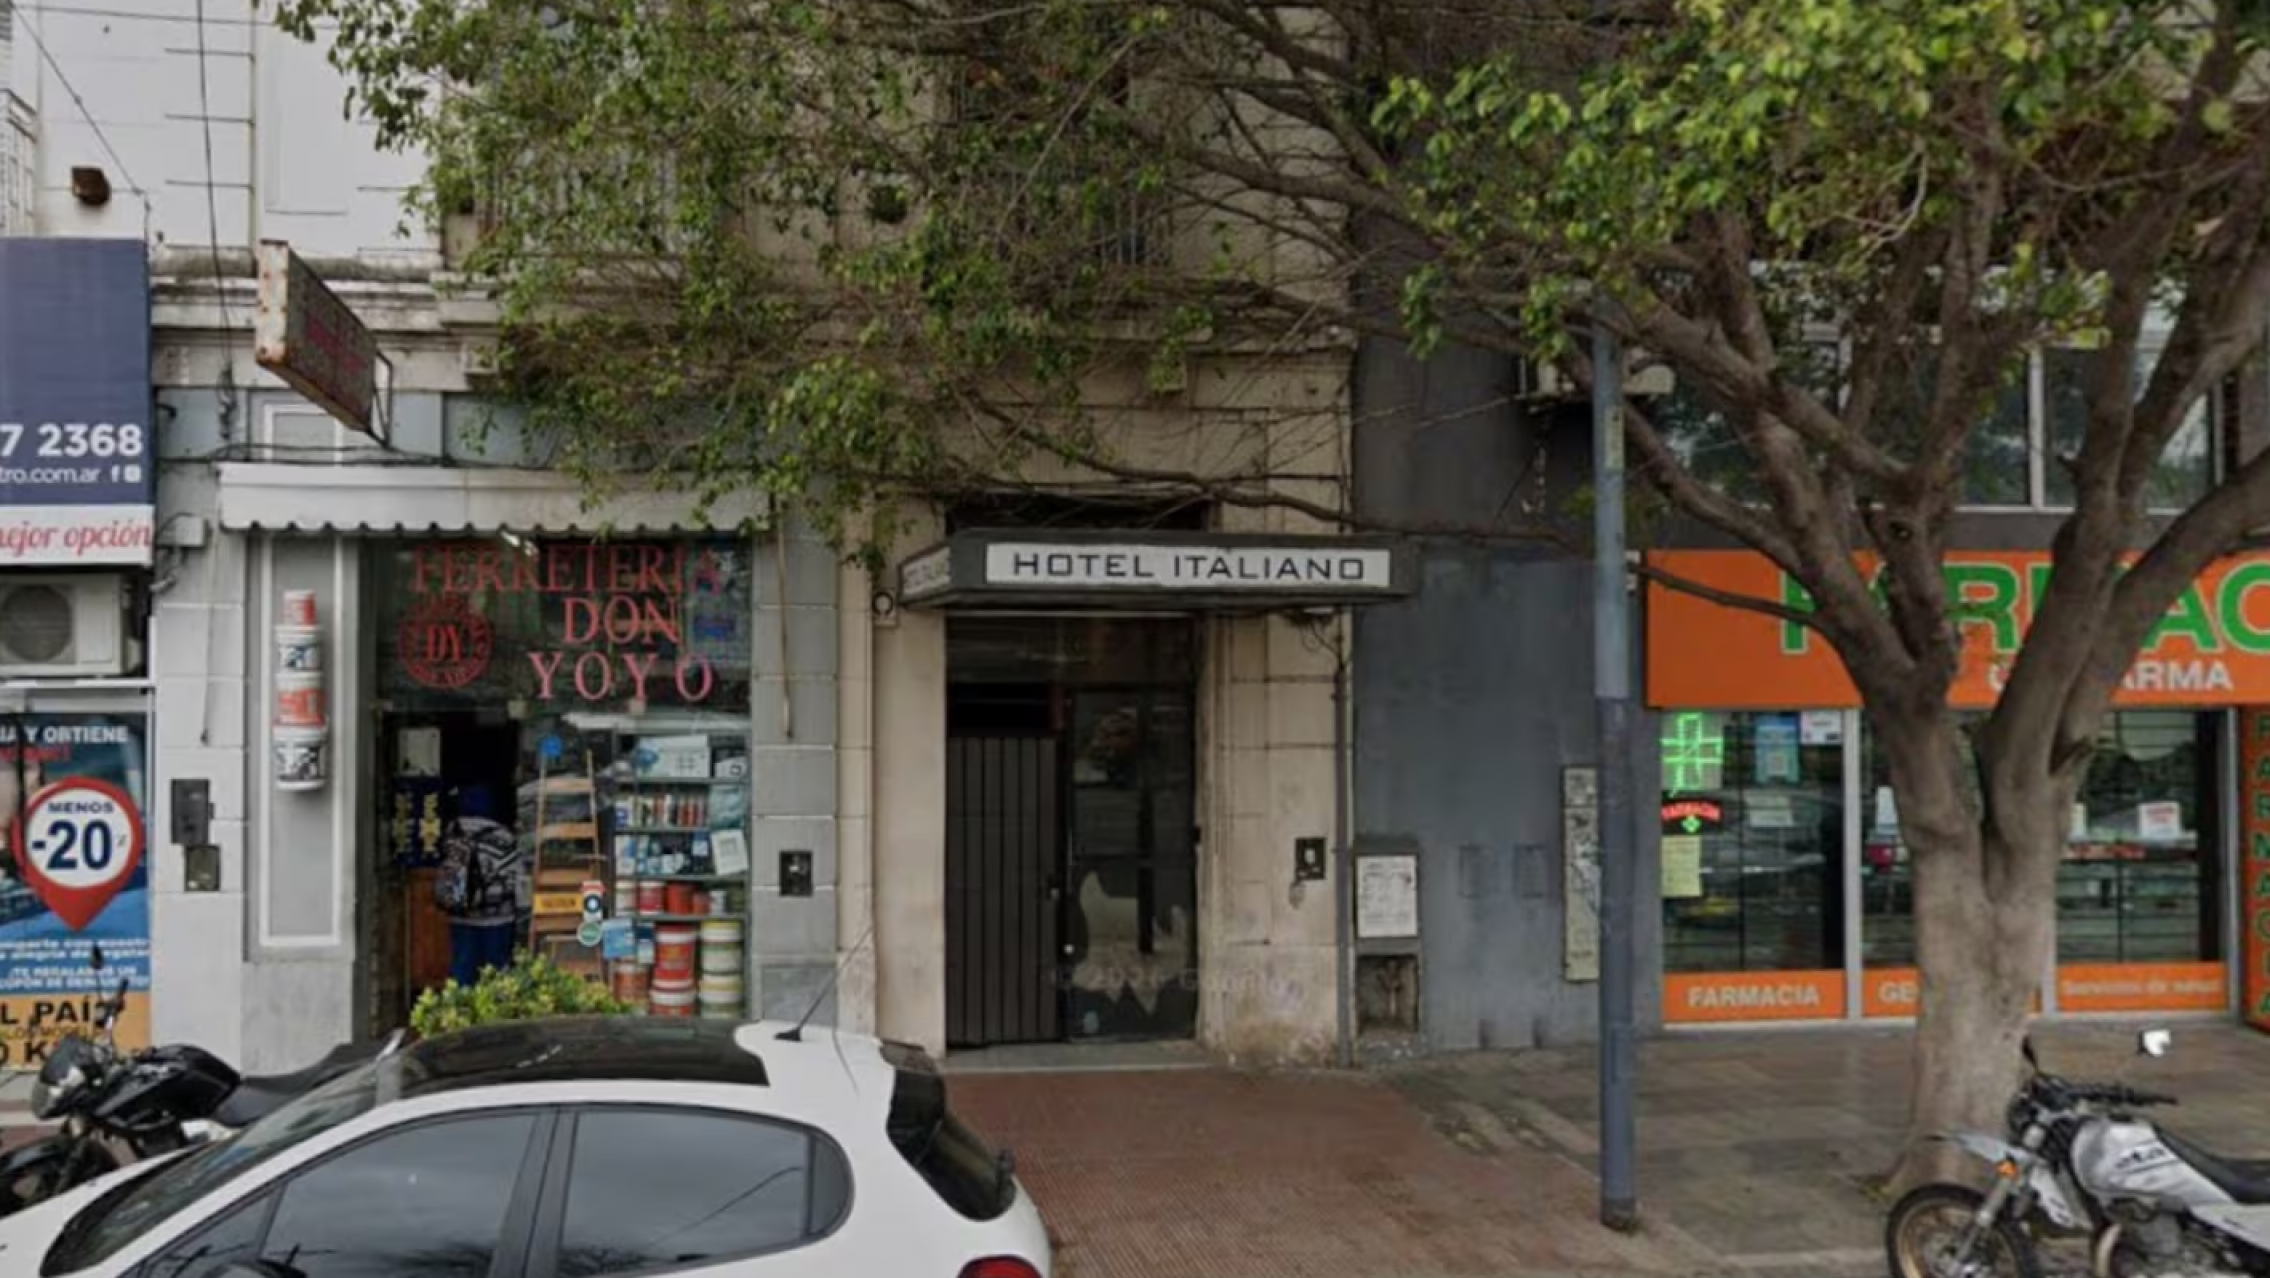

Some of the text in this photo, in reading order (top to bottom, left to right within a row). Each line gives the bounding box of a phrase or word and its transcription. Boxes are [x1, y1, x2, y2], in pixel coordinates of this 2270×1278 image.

[37, 423, 142, 457] 2368
[64, 519, 150, 558] opción
[1013, 551, 1364, 581] HOTEL ITALIANO
[563, 596, 682, 645] DON
[528, 651, 714, 701] YOYO
[48, 802, 114, 817] MENOS
[1687, 984, 1821, 1008] FARMACIA
